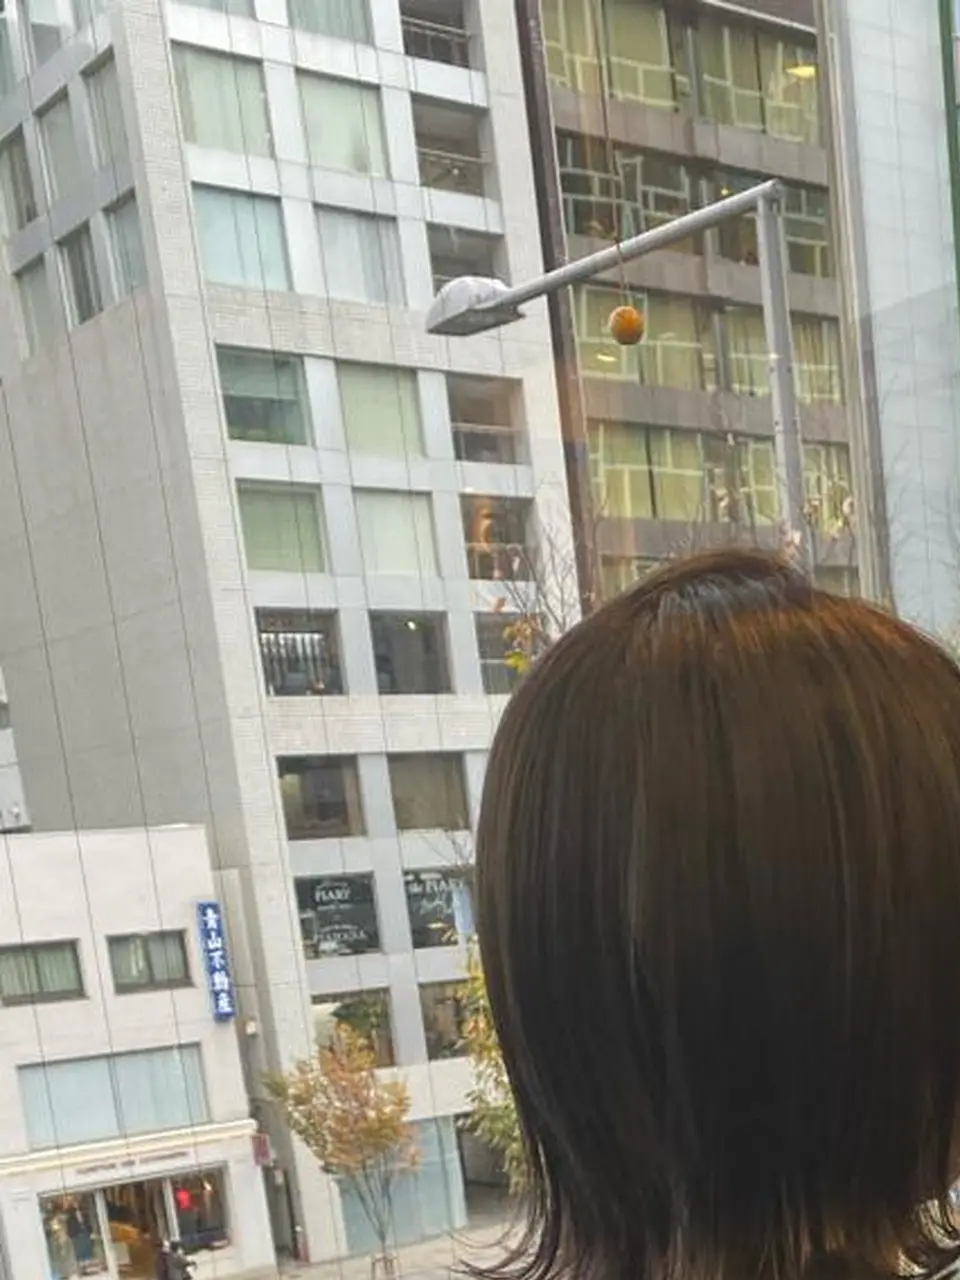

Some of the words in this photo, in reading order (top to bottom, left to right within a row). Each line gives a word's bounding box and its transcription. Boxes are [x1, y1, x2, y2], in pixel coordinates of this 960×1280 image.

[203, 907, 233, 1013] 青山不動産
